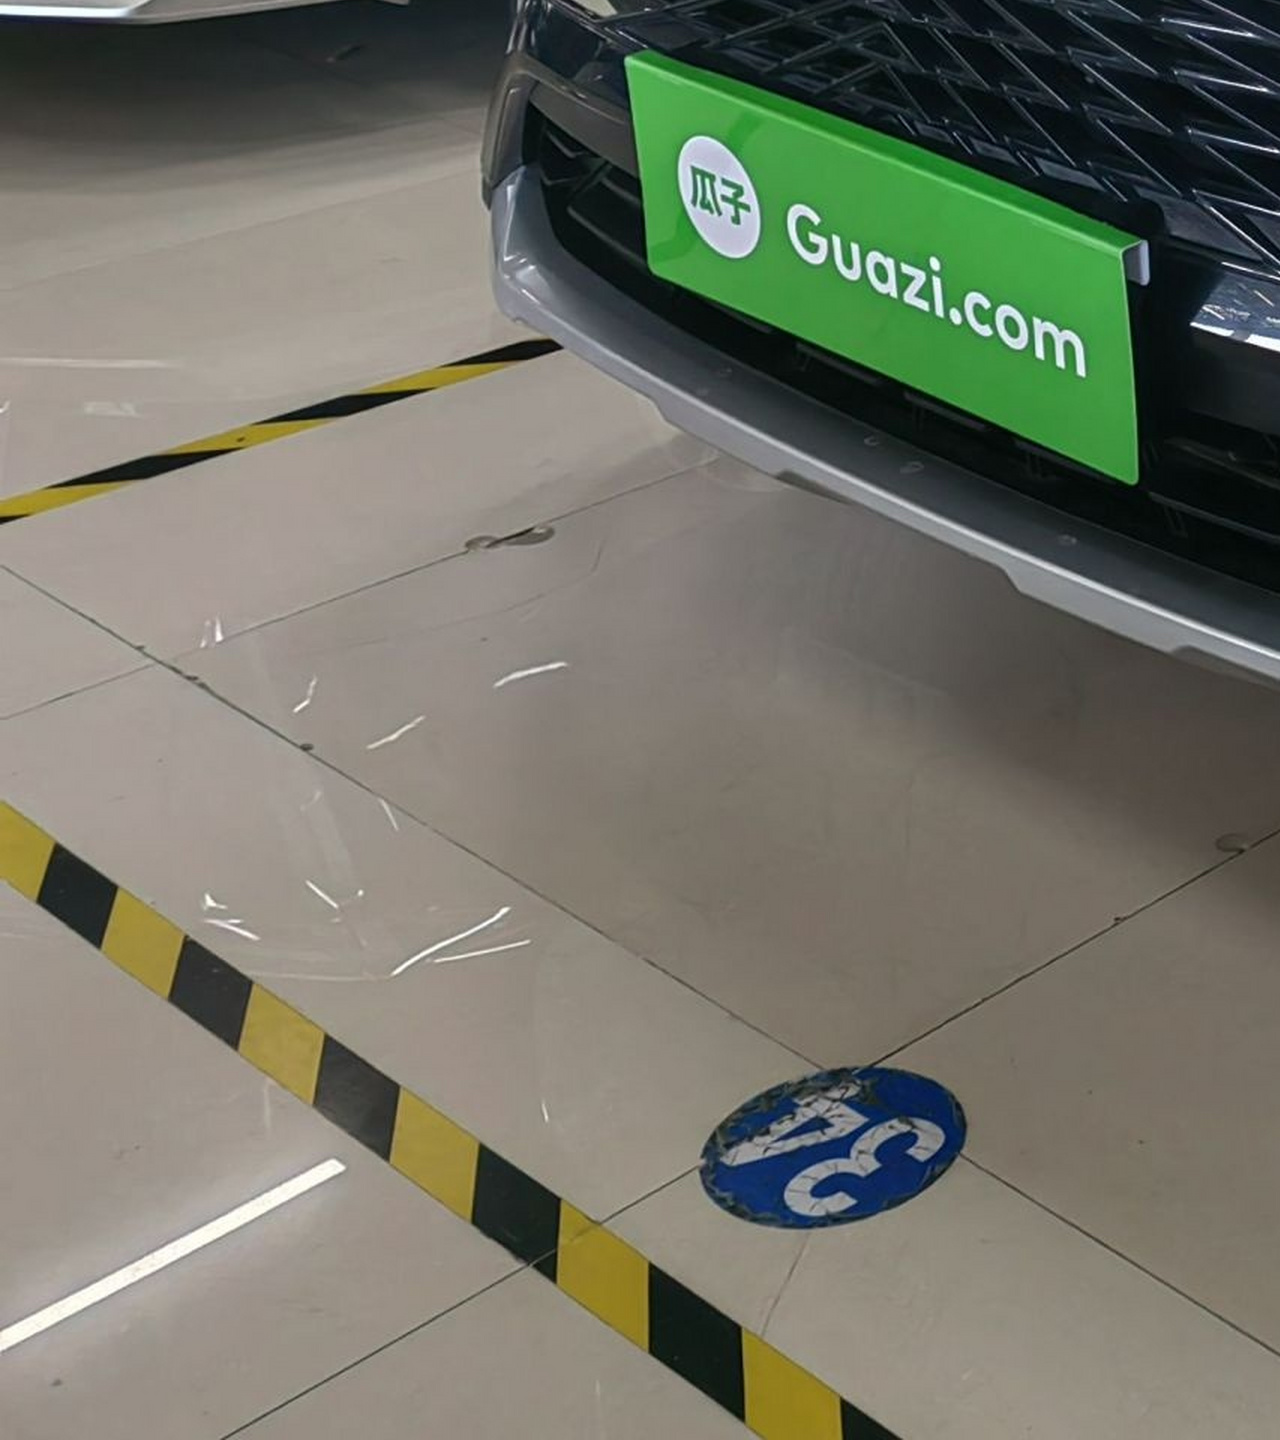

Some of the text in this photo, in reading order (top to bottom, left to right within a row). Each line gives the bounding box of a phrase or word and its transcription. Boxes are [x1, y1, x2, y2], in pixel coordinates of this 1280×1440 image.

[690, 164, 751, 226] 瓜子
[786, 203, 1087, 378] Guazi.com
[719, 1079, 946, 1218] 34
